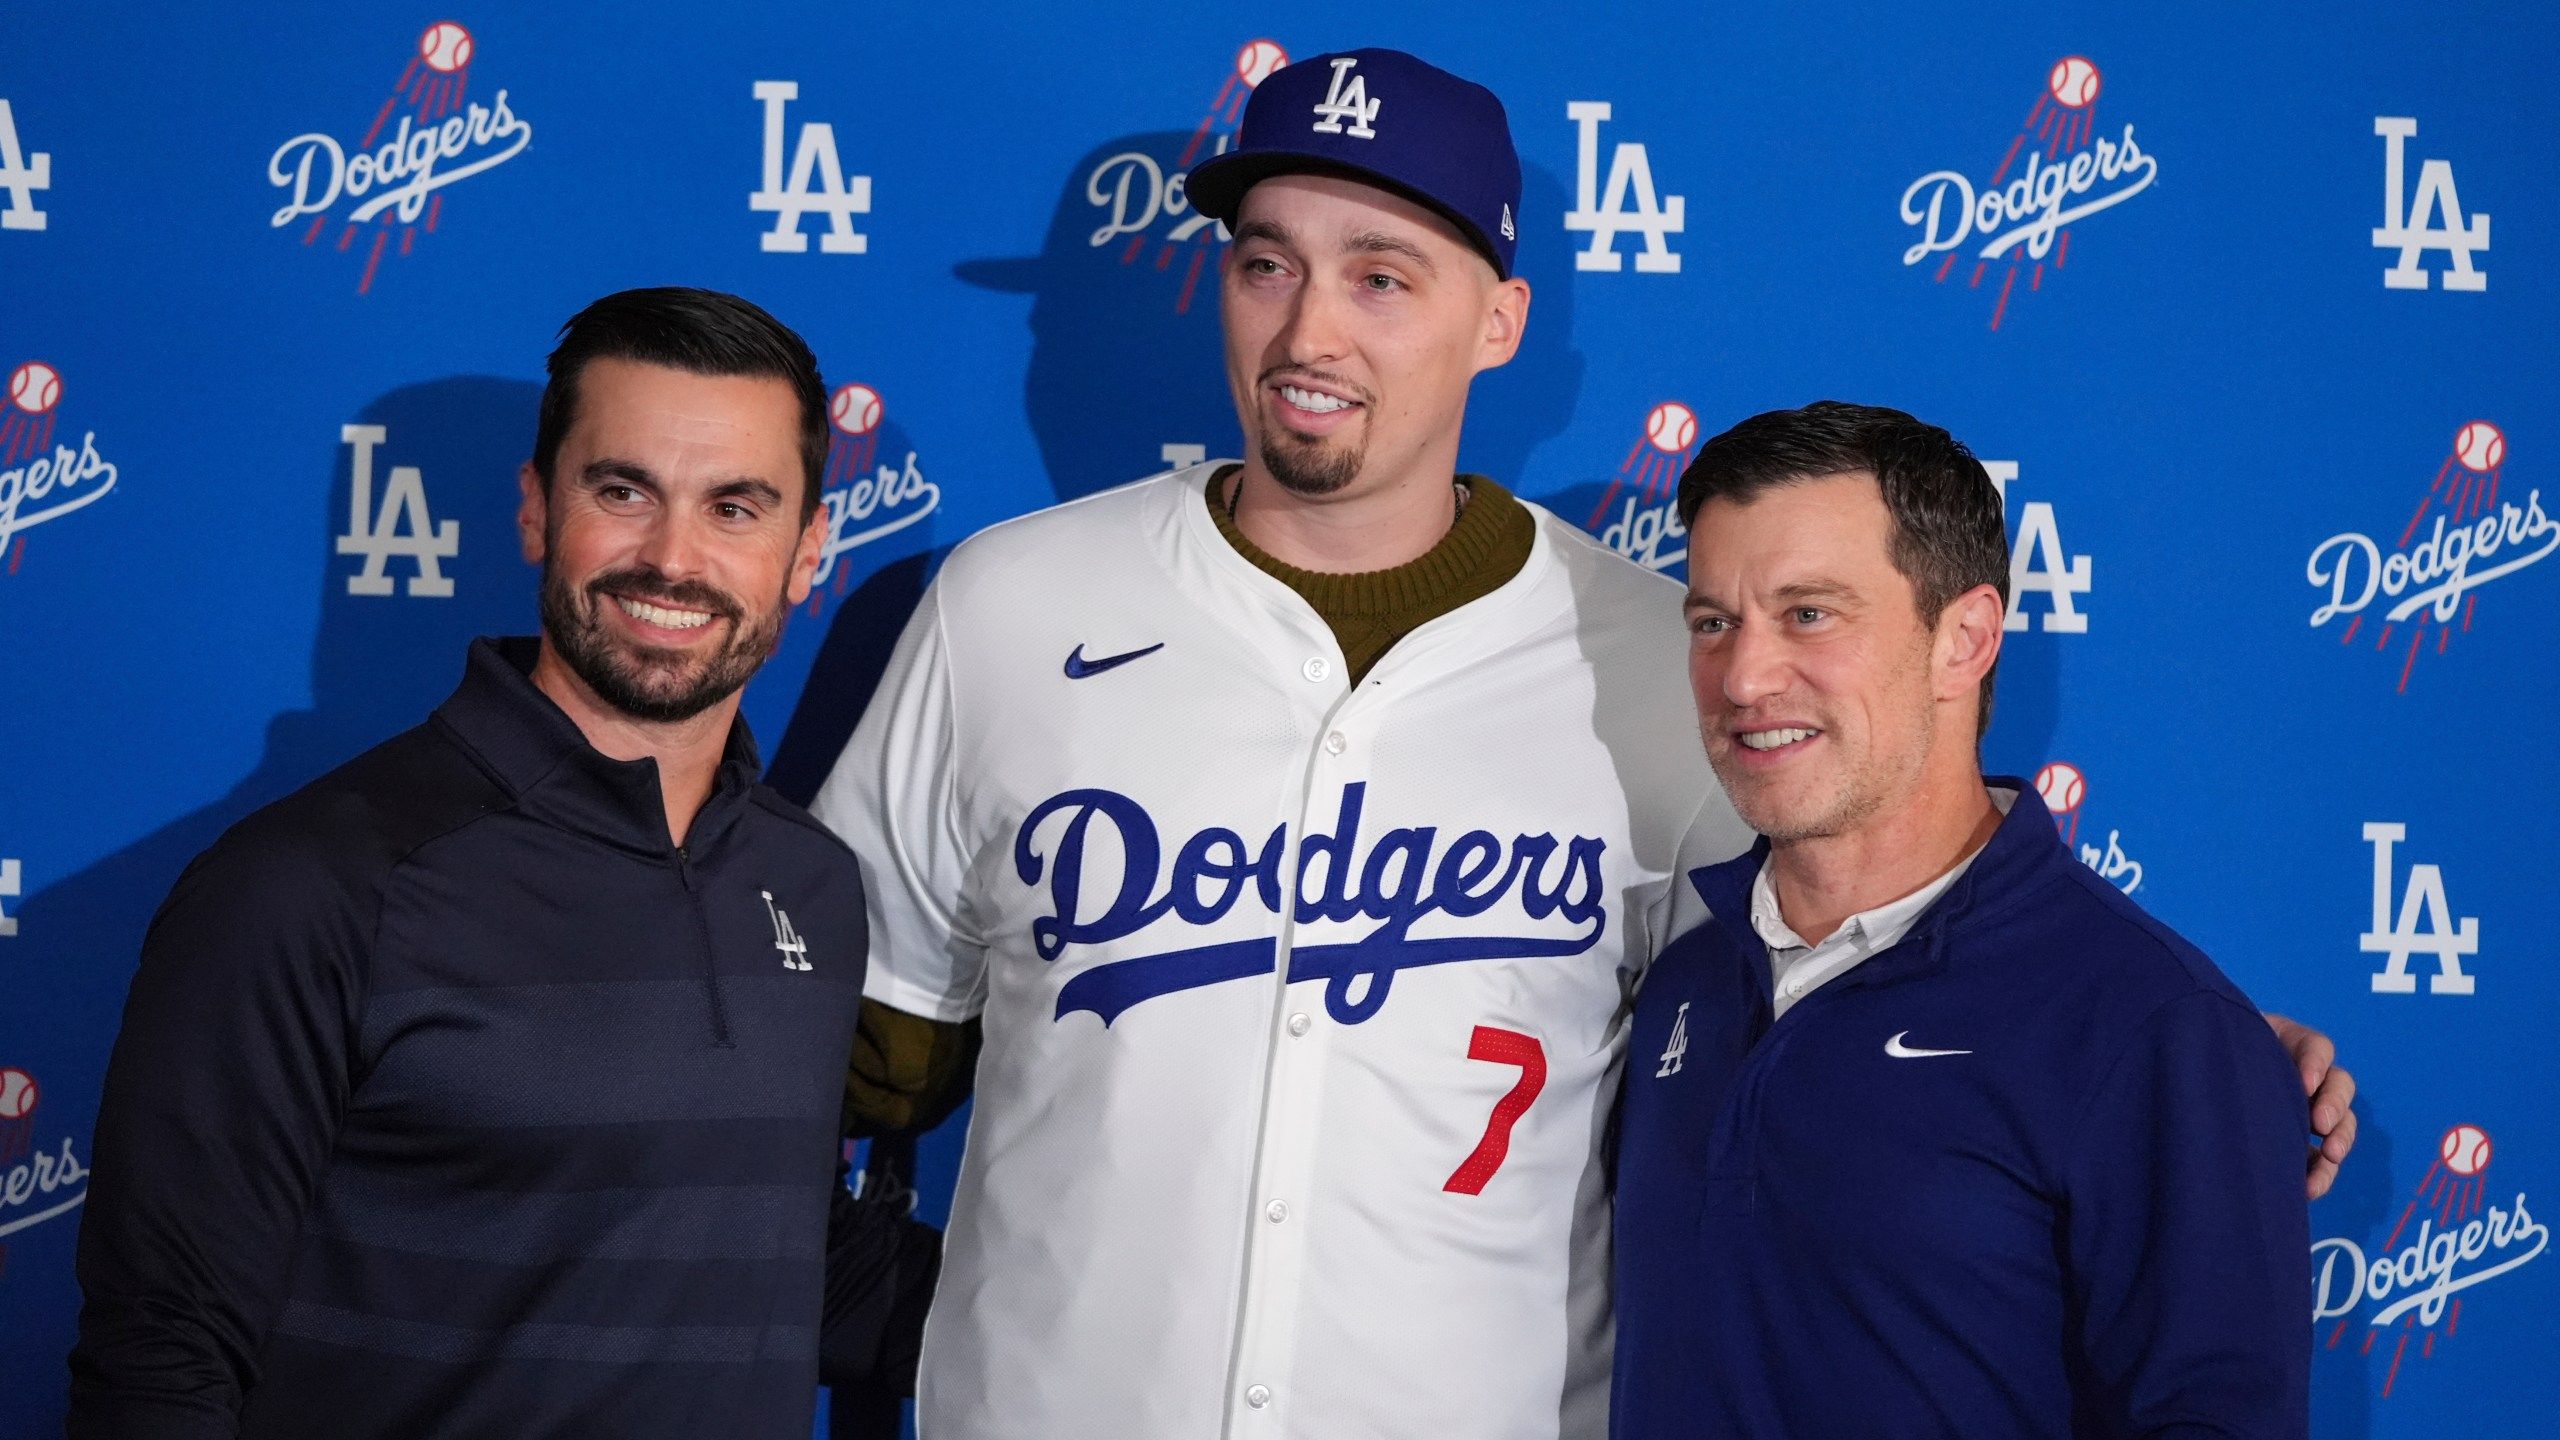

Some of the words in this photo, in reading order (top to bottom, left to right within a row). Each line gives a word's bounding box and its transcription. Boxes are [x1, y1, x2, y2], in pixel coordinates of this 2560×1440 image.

[0, 98, 51, 230] A
[268, 90, 532, 226] Dodgers
[1312, 57, 1381, 140] LA
[750, 81, 871, 254] LA
[1564, 101, 1684, 273] LA
[1900, 125, 2157, 264] Dodgers
[2372, 116, 2491, 291] LA
[0, 431, 117, 559] gers
[337, 424, 460, 598] LA
[2306, 490, 2560, 626] Dodgers
[761, 890, 814, 971] LA
[1015, 781, 1606, 1029] Dodgers
[2360, 822, 2479, 995] LA
[1655, 1002, 1690, 1078] LA
[1442, 1025, 1548, 1196] 7
[2312, 1193, 2549, 1326] Dodgers
